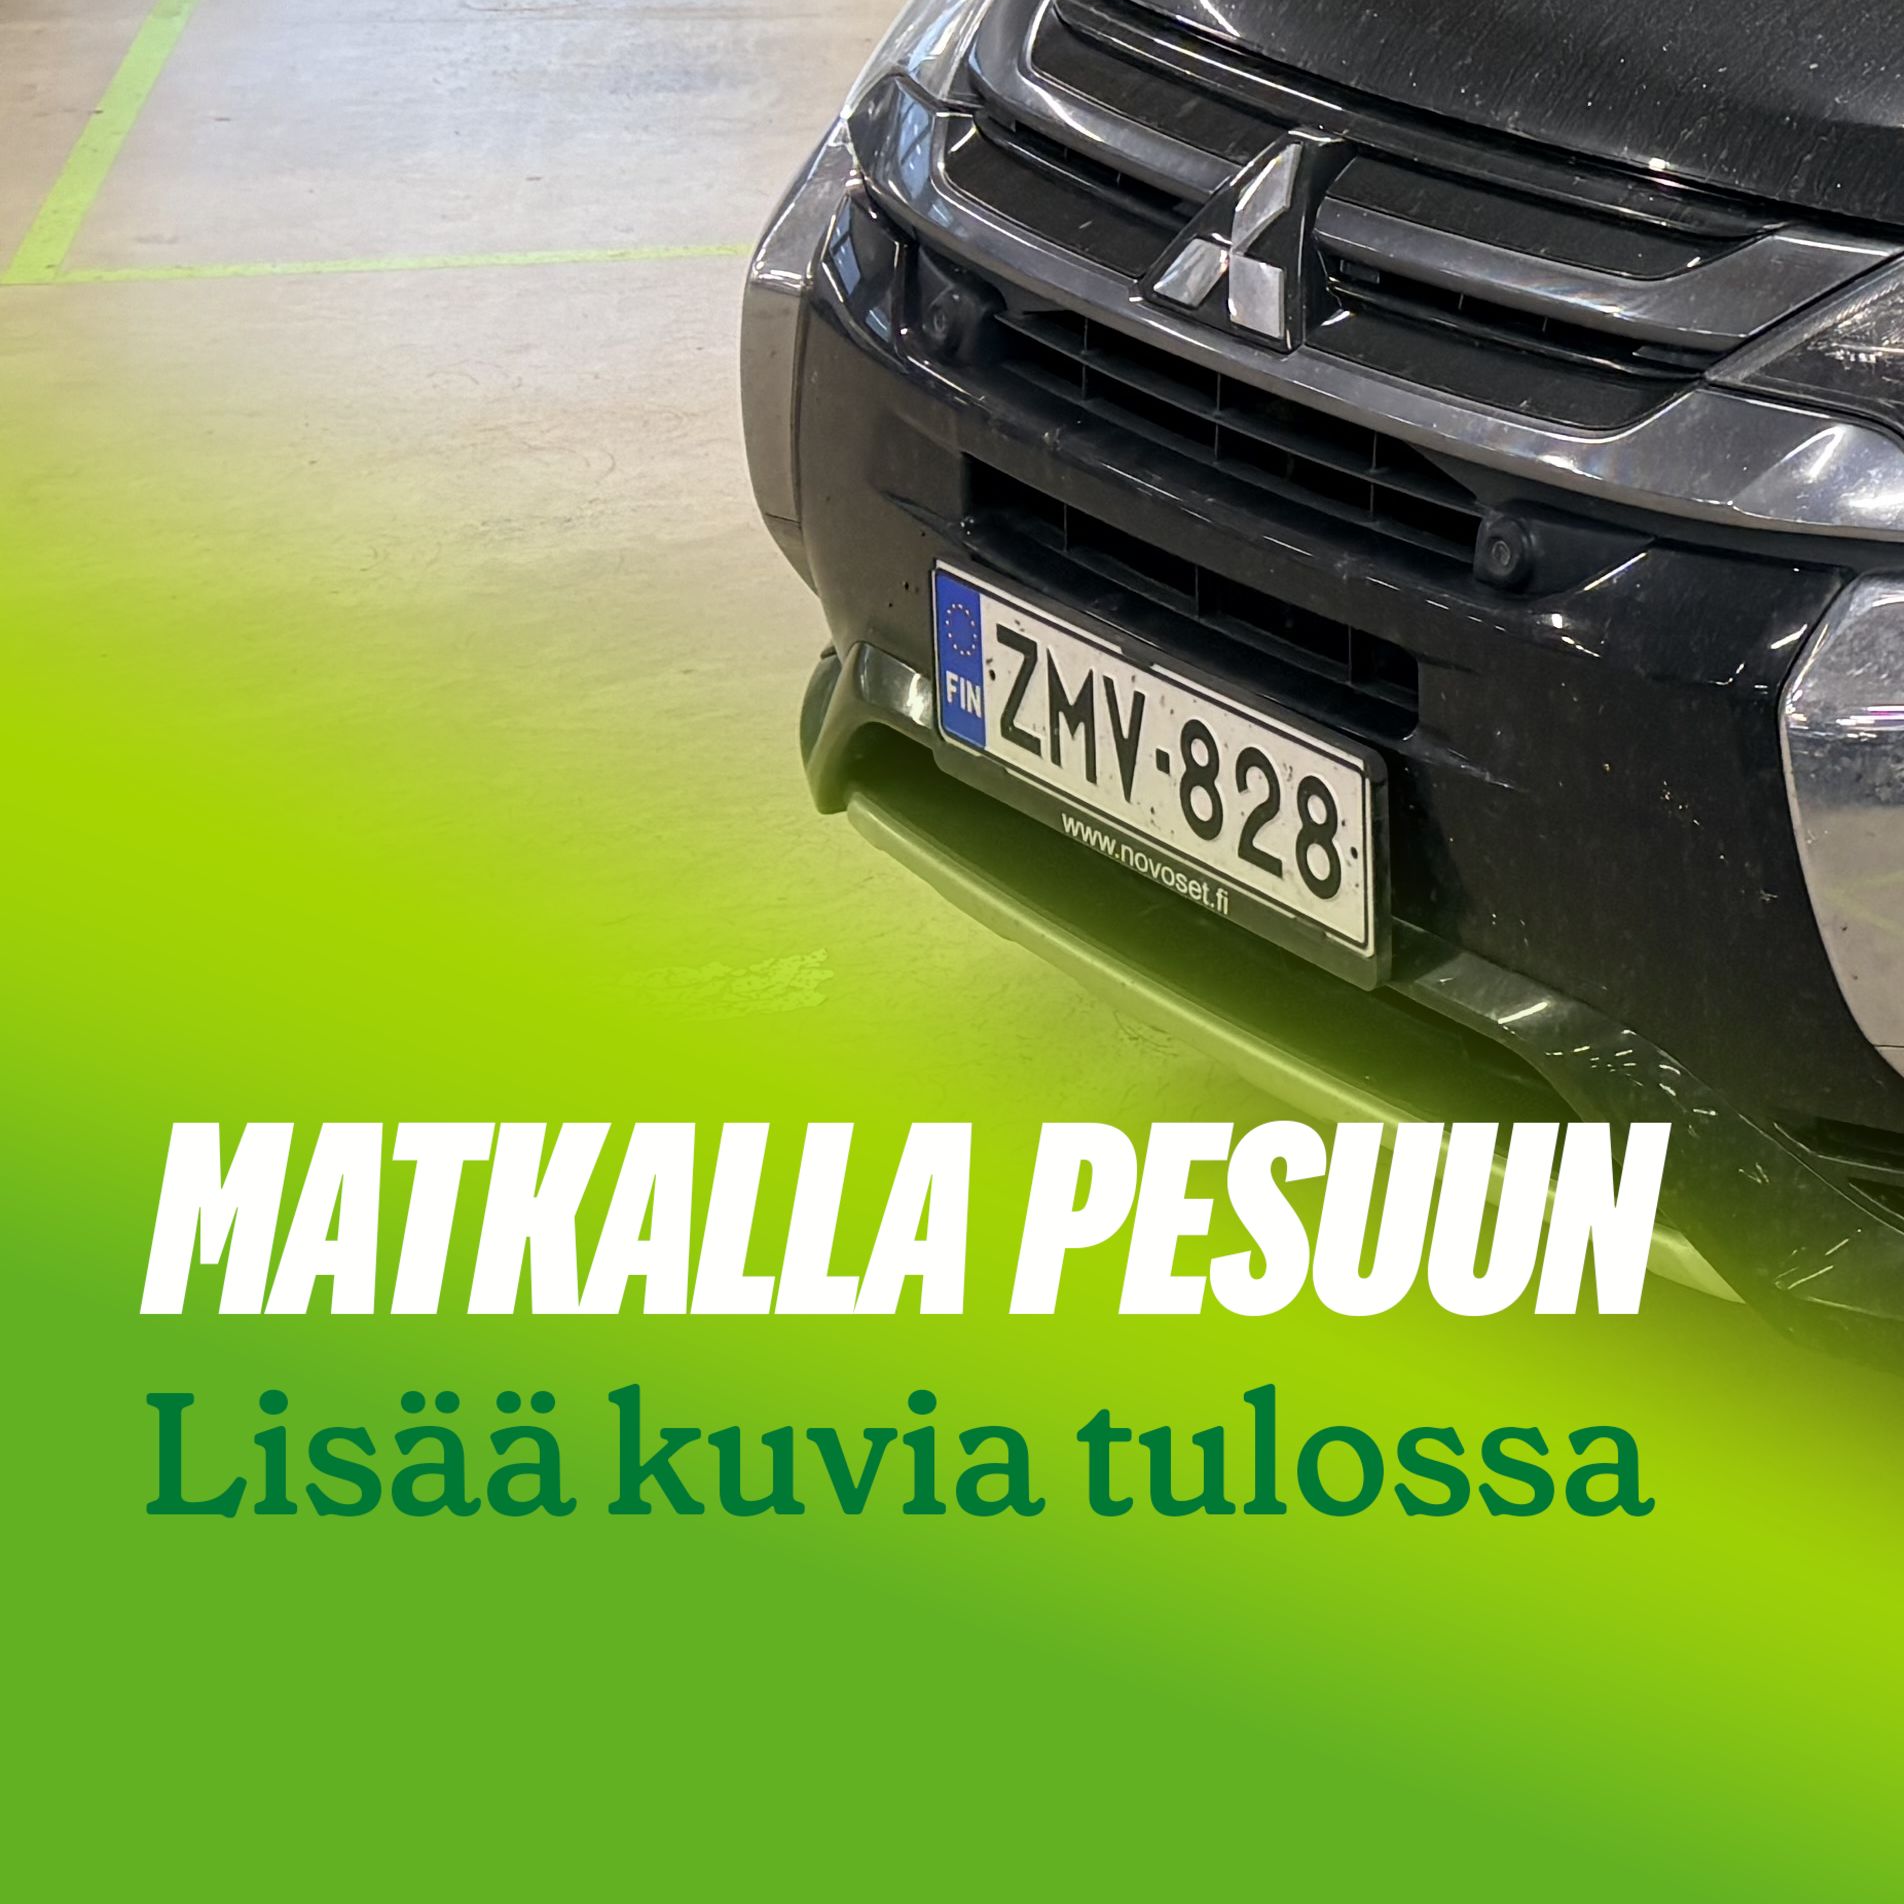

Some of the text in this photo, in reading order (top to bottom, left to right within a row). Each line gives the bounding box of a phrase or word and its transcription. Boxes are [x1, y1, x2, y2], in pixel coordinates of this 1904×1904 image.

[945, 670, 984, 718] FIN
[995, 623, 1342, 901] ZMV-828
[1060, 810, 1230, 916] www.novoset.fi
